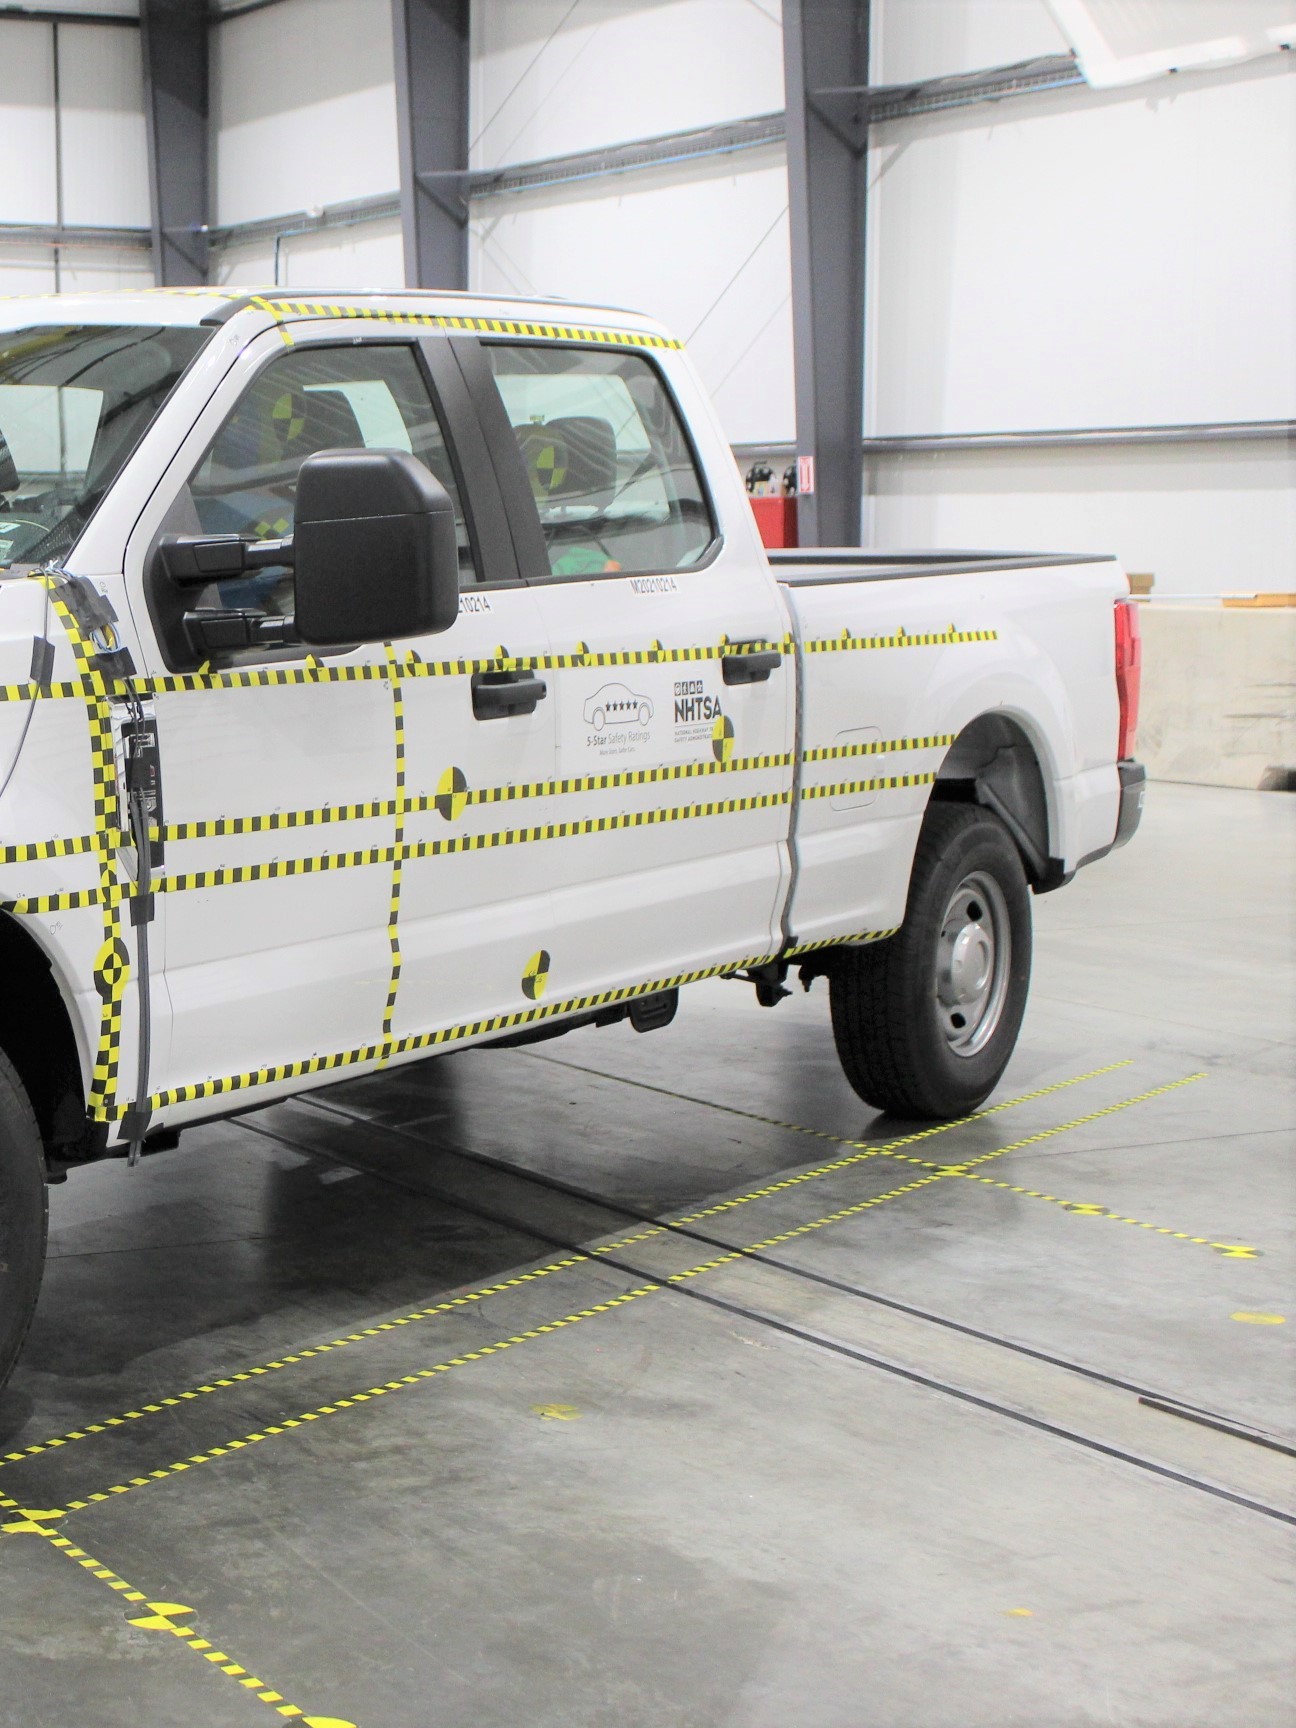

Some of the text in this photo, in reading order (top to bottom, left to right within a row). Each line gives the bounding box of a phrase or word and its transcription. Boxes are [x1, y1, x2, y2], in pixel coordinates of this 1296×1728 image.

[630, 578, 677, 594] M20210214
[458, 596, 491, 613] 10214
[675, 696, 722, 722] NHTSA
[587, 731, 650, 746] 5-Star Safety Ratings
